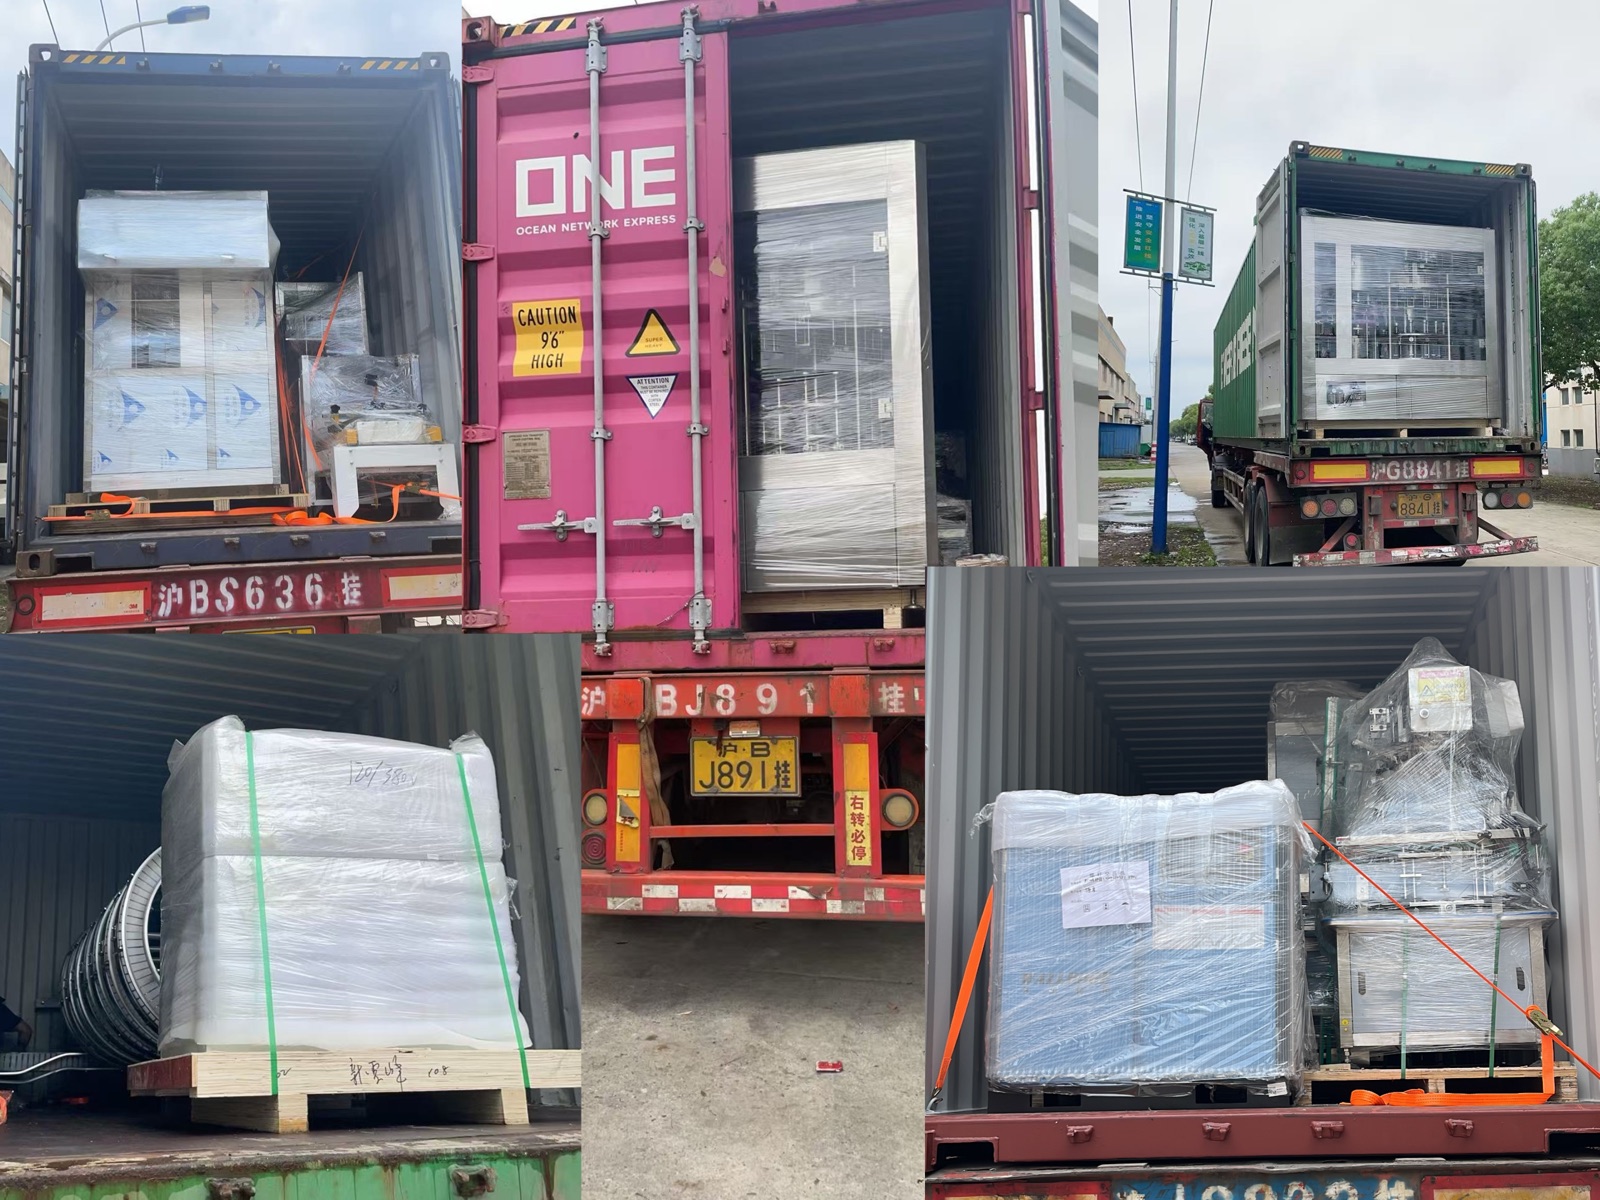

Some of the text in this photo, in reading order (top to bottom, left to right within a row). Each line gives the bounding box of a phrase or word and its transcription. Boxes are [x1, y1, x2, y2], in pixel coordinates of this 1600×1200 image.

[515, 145, 676, 218] ONE
[515, 223, 557, 236] OCEAN
[623, 214, 676, 228] EXPRESS
[517, 306, 577, 327] CAUTION
[531, 353, 564, 370] HIGH
[848, 794, 867, 861] 右转必停
